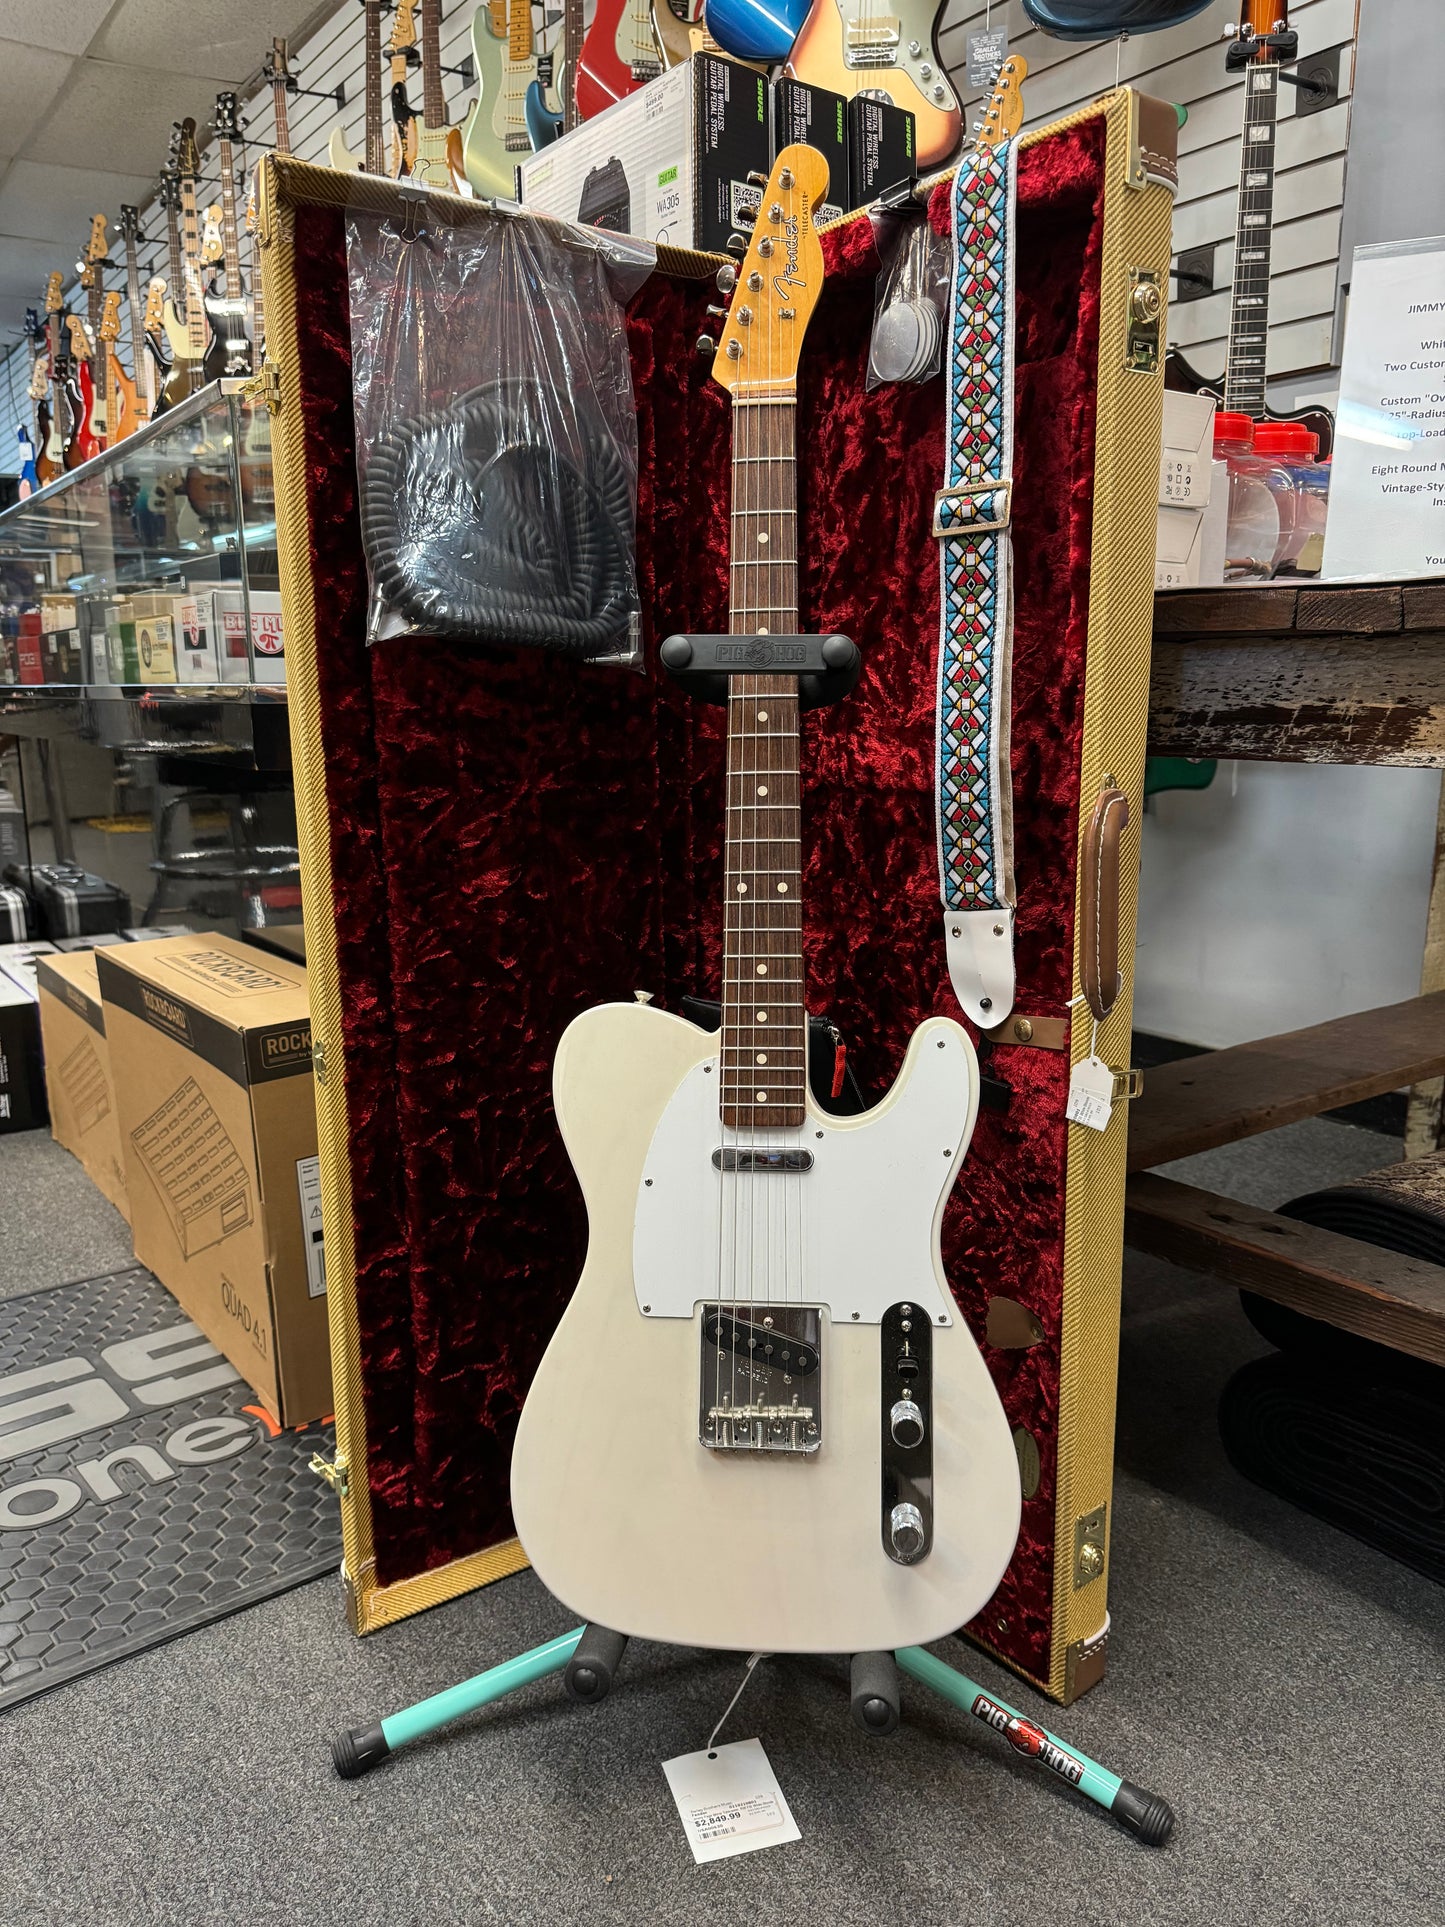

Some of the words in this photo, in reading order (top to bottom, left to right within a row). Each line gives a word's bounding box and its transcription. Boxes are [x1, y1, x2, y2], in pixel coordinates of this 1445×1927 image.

[709, 60, 717, 90] GUITAR
[710, 91, 718, 116] PEDAL
[717, 93, 725, 131] WIRELESS
[757, 77, 765, 123] SHURE
[871, 106, 879, 132] DIGITAL
[710, 118, 719, 149] SYSTEM
[659, 168, 677, 185] GUITAR
[656, 193, 680, 214] WA305
[773, 215, 807, 300] Fender
[1408, 302, 1445, 314] JIMMY
[1384, 363, 1407, 372] Two
[1380, 395, 1421, 406] Custom
[1371, 465, 1399, 476] Eight
[1401, 463, 1437, 473] Round
[183, 952, 282, 989] ROCKBOARD
[266, 1031, 312, 1056] ROCK
[222, 1282, 251, 1332] QUAD
[253, 1320, 267, 1354] 4.1
[975, 1698, 1008, 1732] PIG
[1041, 1742, 1081, 1782] HOG
[695, 1811, 741, 1828] $2,849.99
